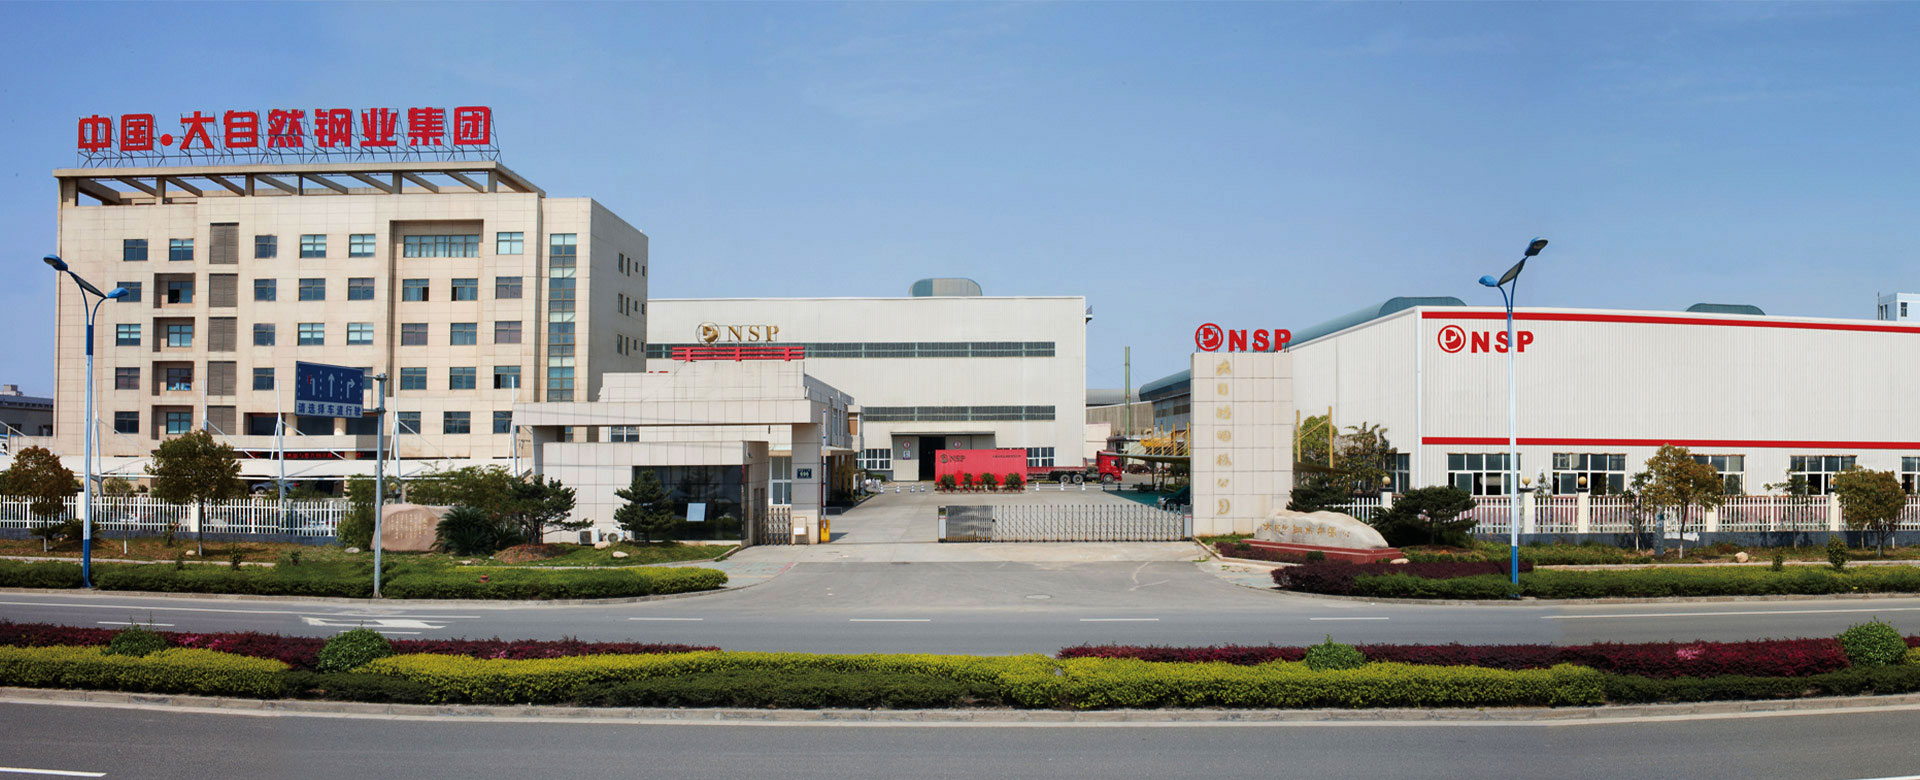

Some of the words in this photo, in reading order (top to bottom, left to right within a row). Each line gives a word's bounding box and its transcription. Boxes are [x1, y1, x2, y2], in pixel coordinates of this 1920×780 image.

[728, 325, 779, 342] NSP
[1228, 329, 1292, 352] NSP
[1471, 330, 1534, 353] NSP
[298, 402, 361, 417] 请选择车道行驶
